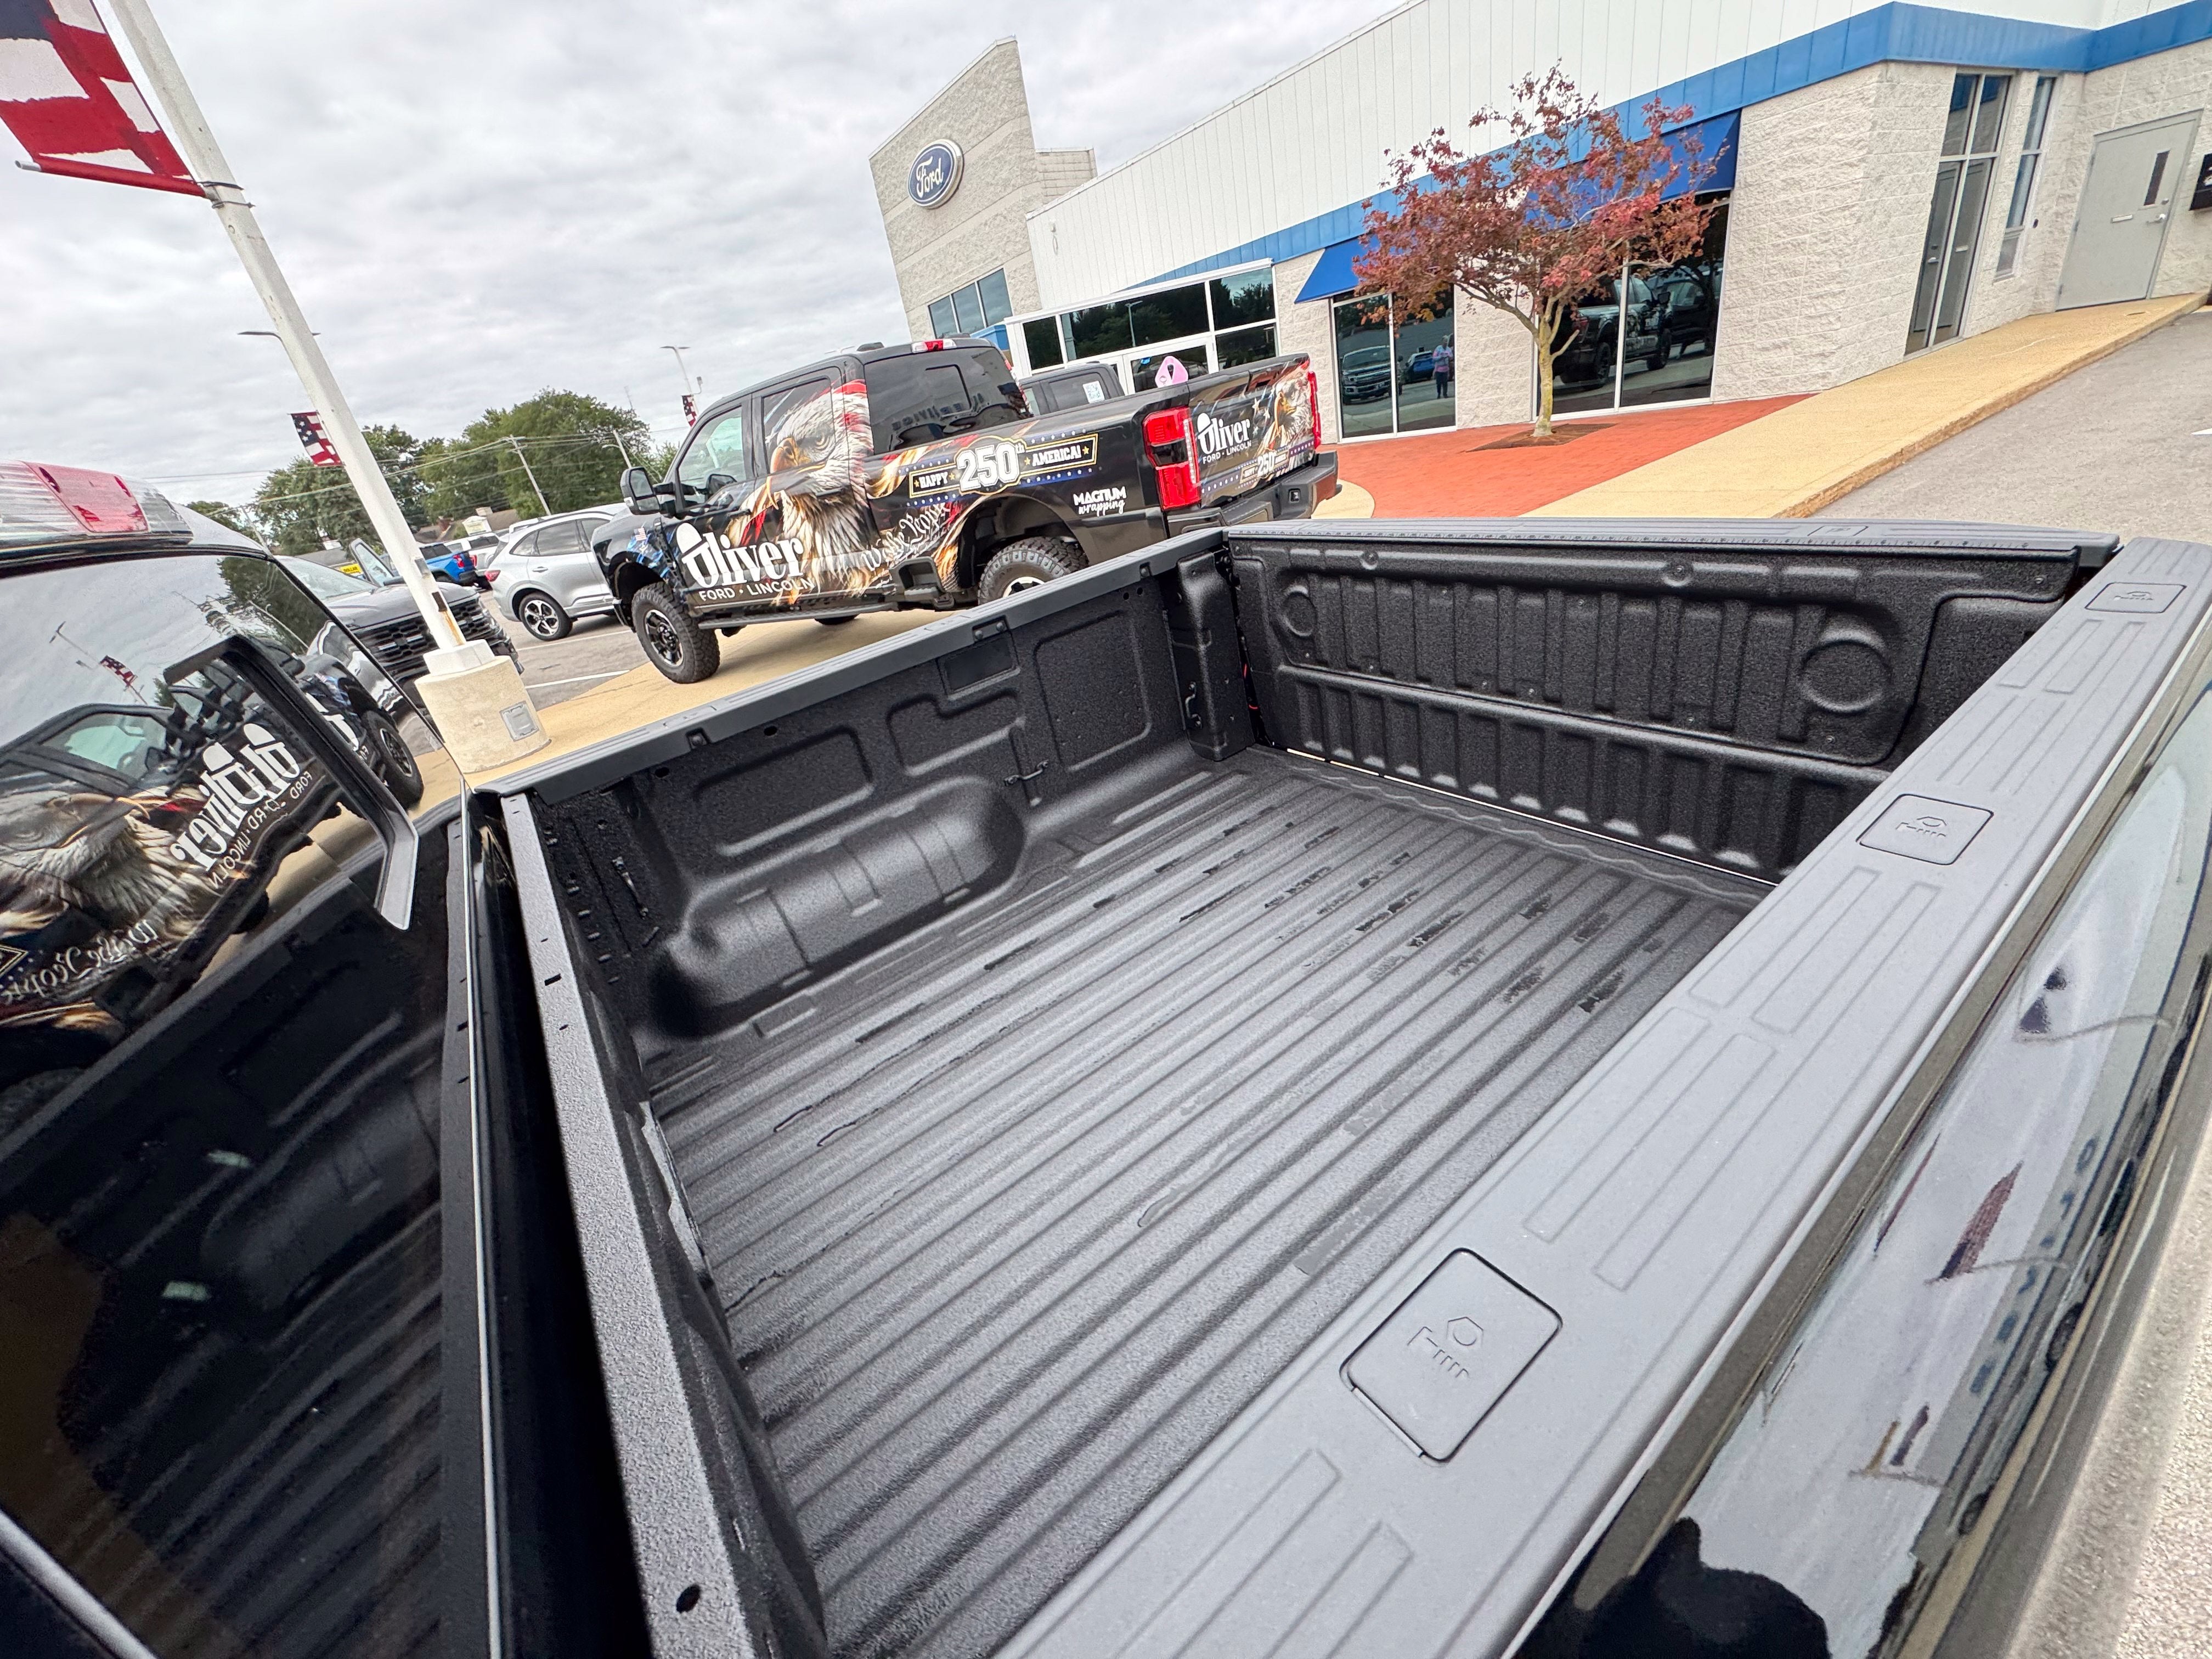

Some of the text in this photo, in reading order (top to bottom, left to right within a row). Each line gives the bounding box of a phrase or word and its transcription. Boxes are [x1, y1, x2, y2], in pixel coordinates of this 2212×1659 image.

[916, 156, 944, 198] Ford
[1197, 413, 1251, 454] Oliver
[918, 471, 948, 489] HAPPY
[1032, 444, 1082, 467] AMERICA!
[1203, 440, 1252, 465] FORD LINCOLN
[1073, 486, 1127, 506] MAGNUM
[1078, 499, 1126, 517] wrapping
[676, 522, 804, 588] Oliver
[698, 577, 815, 602] FORD LINCOLN
